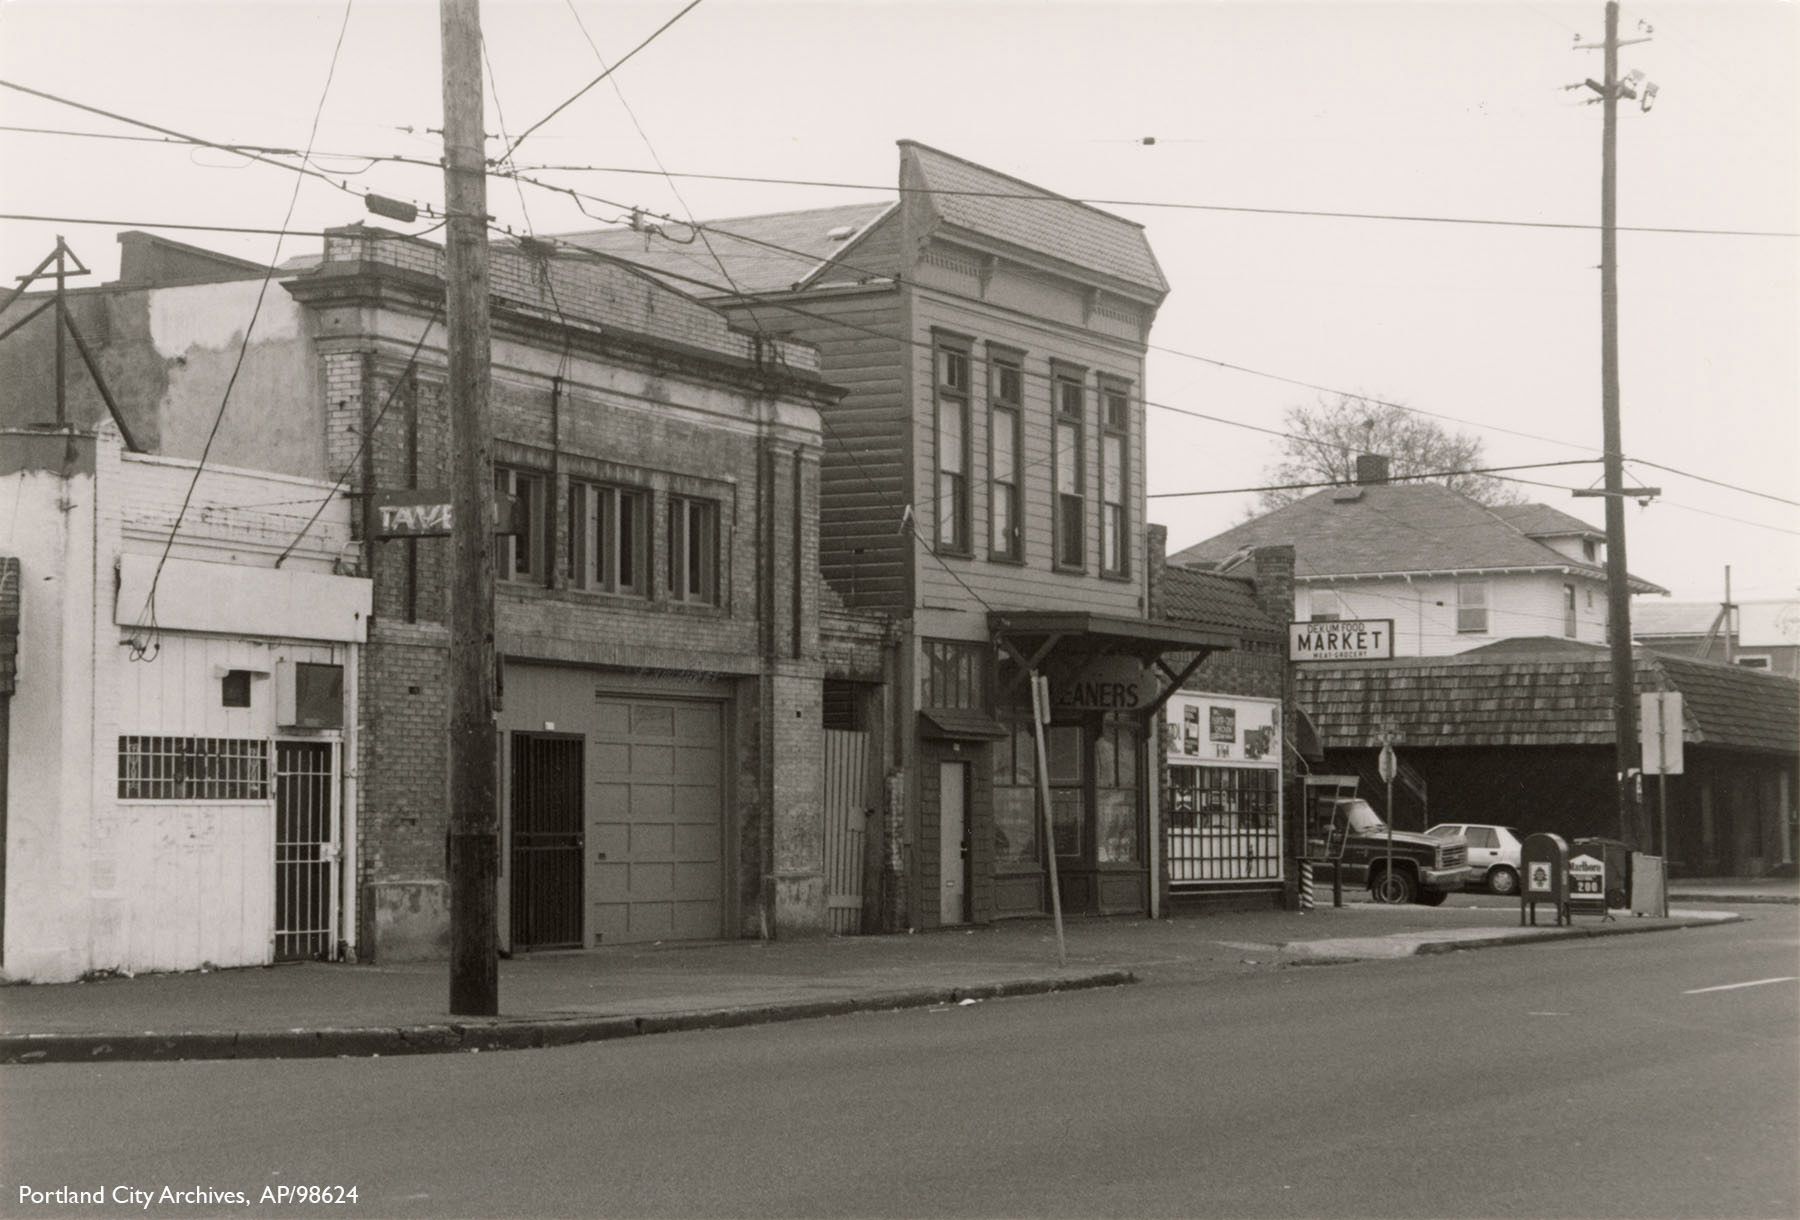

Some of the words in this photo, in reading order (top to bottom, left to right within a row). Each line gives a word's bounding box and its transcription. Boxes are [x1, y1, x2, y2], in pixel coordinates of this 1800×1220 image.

[1307, 624, 1339, 634] DEKUM
[1341, 622, 1365, 632] FOOD
[1298, 631, 1382, 651] MARKET
[1048, 682, 1139, 708] LEANERS
[1569, 860, 1602, 873] Marlboro
[1577, 881, 1598, 892] 200
